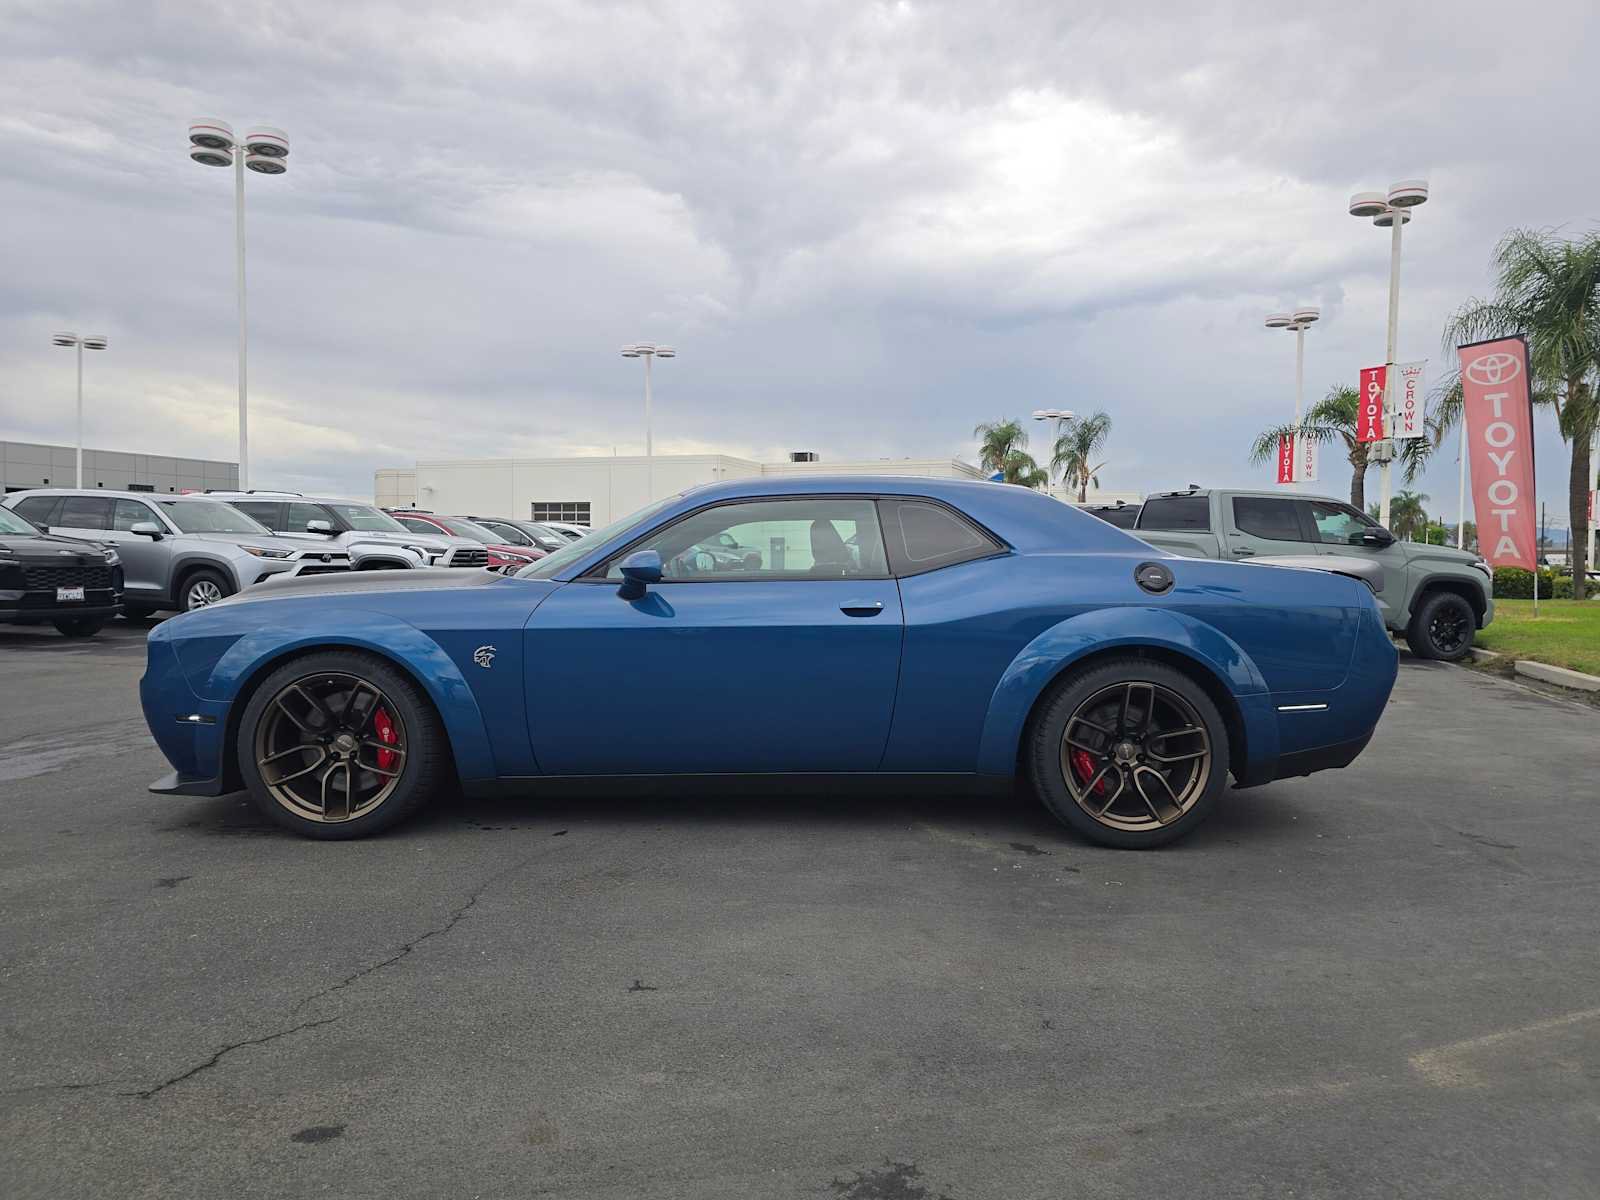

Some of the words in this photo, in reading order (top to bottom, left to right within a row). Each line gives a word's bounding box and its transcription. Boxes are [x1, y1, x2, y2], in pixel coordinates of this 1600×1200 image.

[1366, 370, 1379, 438] TOYOTA
[1404, 380, 1416, 431] CROWN
[1484, 392, 1521, 559] TOYOTA
